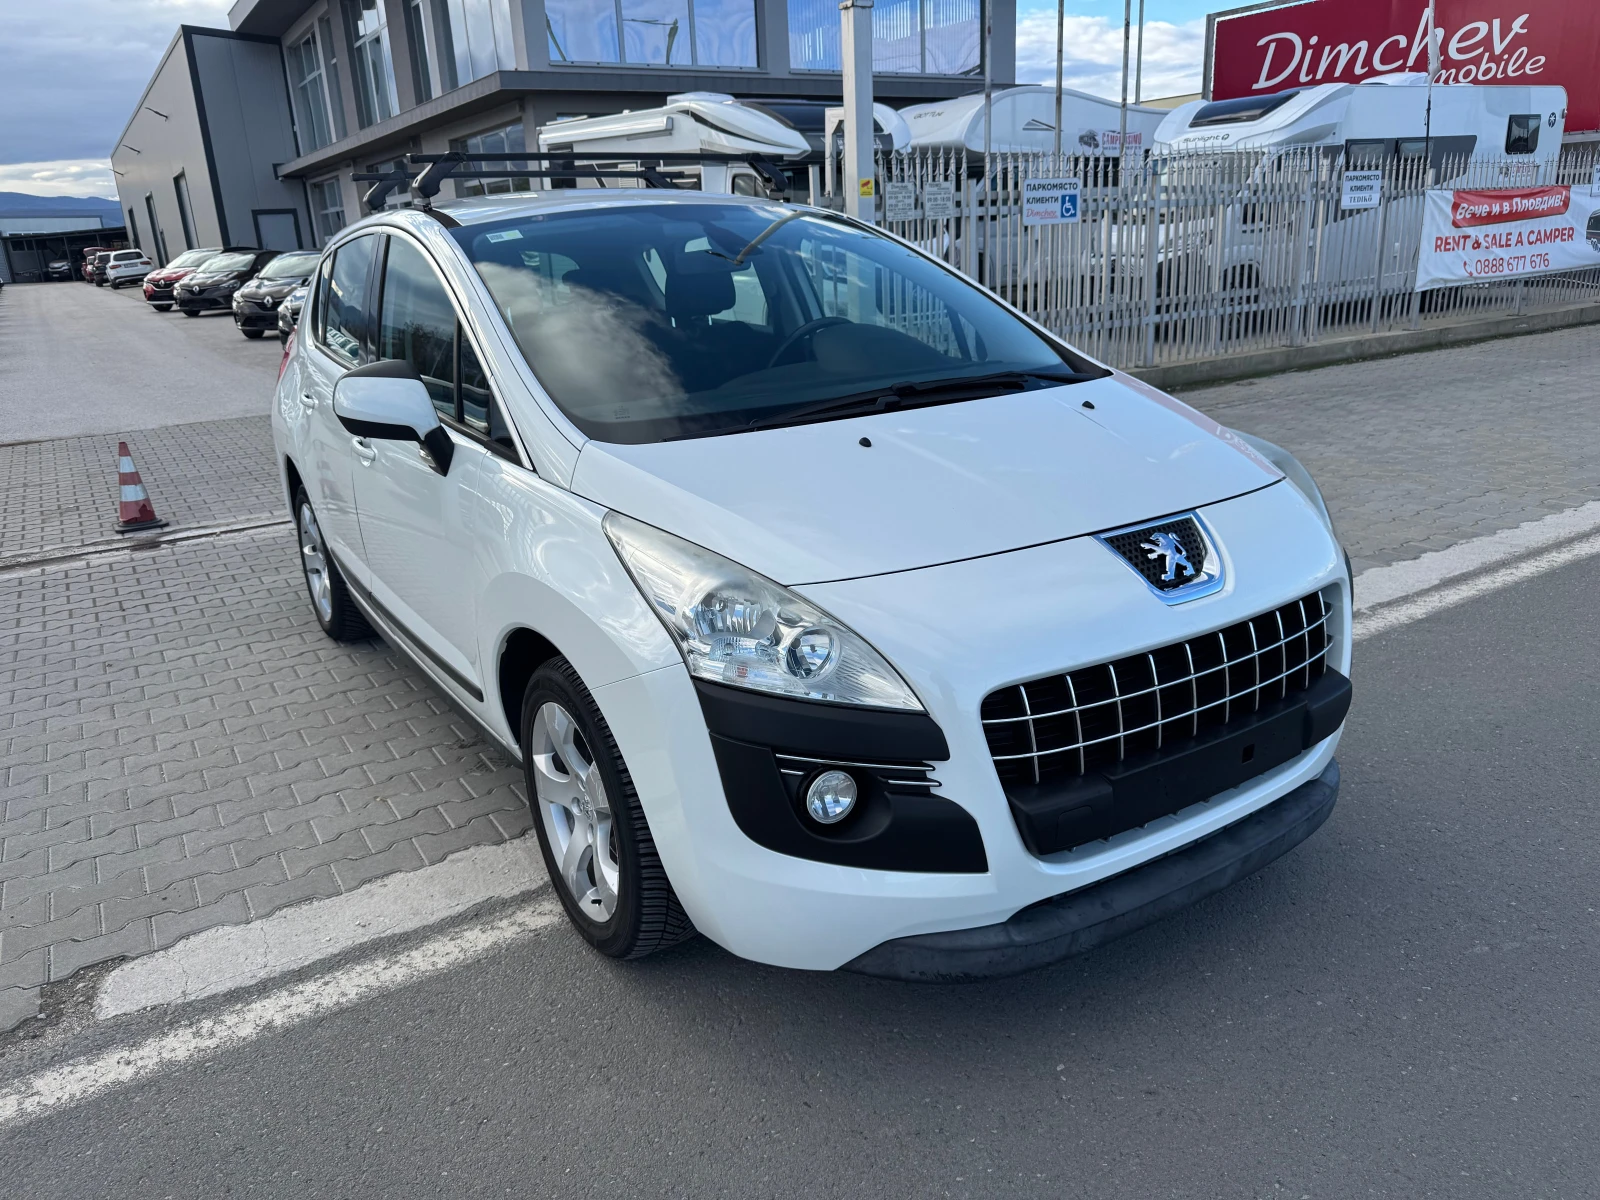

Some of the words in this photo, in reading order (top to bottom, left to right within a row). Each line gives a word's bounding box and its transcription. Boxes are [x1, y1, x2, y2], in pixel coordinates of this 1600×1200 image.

[1252, 7, 1530, 89] Dimchev
[1345, 174, 1380, 182] ПАРКОМЯСТО
[1026, 182, 1079, 192] ПАРКОМЯСТО
[1350, 184, 1374, 192] КЛИЕНТИ
[1026, 196, 1059, 205] КЛИЕНТИ
[1456, 203, 1489, 220] Вече
[1491, 202, 1500, 215] и
[1502, 201, 1510, 214] в
[1512, 191, 1566, 213] Пловдив!
[1434, 234, 1471, 253] RENT
[1471, 235, 1482, 250] &
[1485, 232, 1512, 249] SALE
[1515, 230, 1524, 247] A
[1526, 226, 1575, 246] CAMPER
[1475, 257, 1504, 274] 0888
[1507, 255, 1527, 272] 677
[1530, 252, 1550, 269] 676
